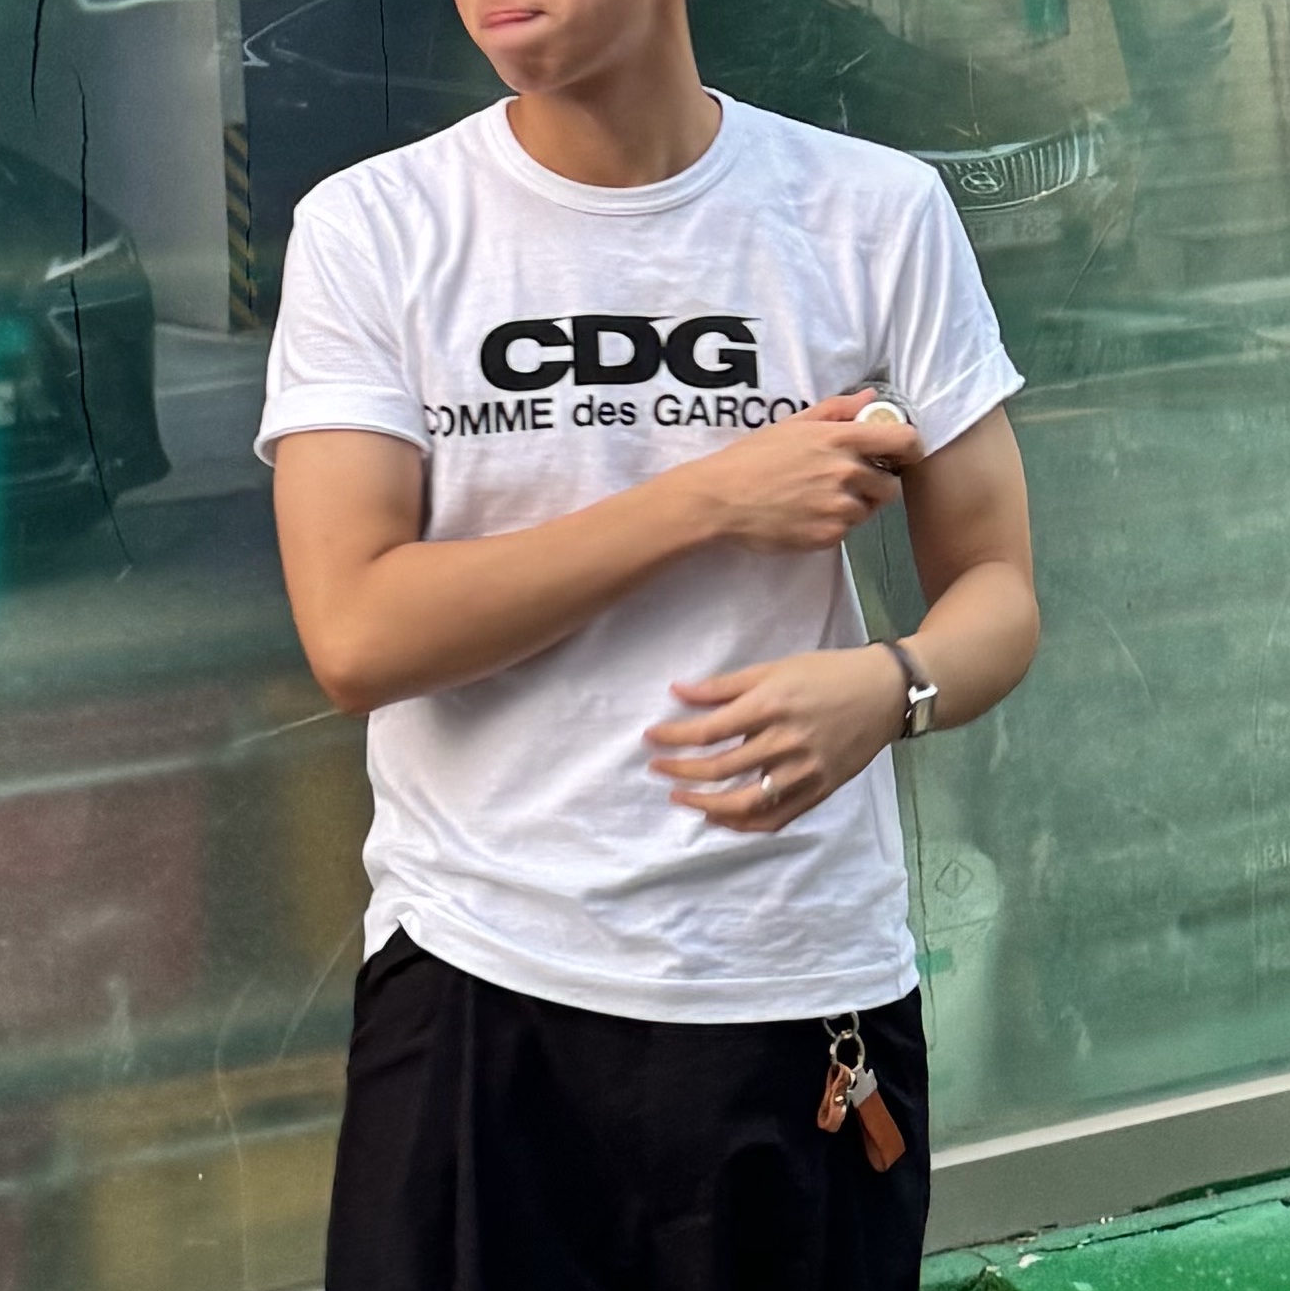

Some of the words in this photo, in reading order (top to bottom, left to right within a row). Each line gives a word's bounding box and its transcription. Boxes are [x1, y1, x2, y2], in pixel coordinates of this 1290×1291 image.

[480, 315, 761, 391] CDG
[573, 394, 636, 427] des
[654, 393, 811, 429] GARCO
